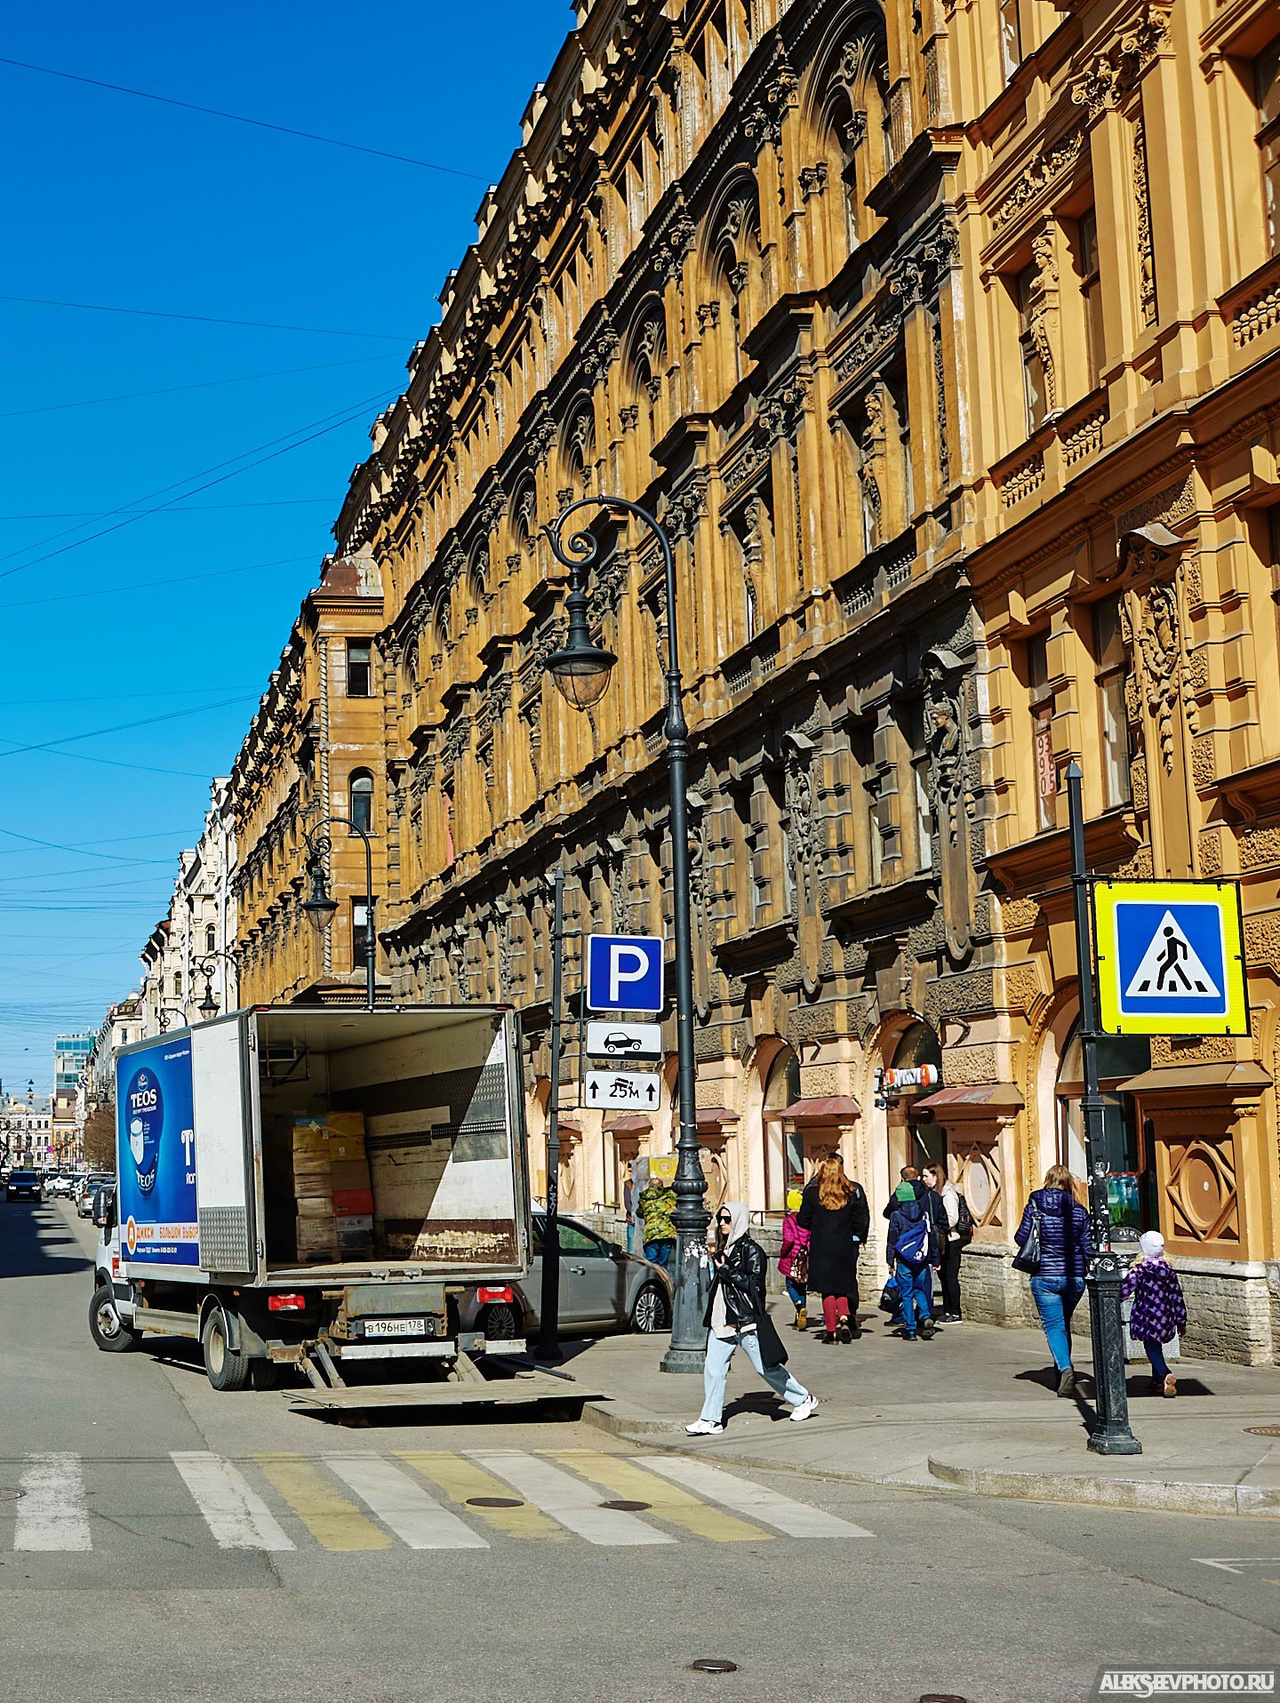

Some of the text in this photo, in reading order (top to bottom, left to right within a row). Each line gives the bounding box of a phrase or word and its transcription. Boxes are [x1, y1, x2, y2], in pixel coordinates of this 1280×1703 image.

[609, 944, 650, 1002] P
[130, 1089, 157, 1108] TEOS
[135, 1168, 155, 1188] TEOS
